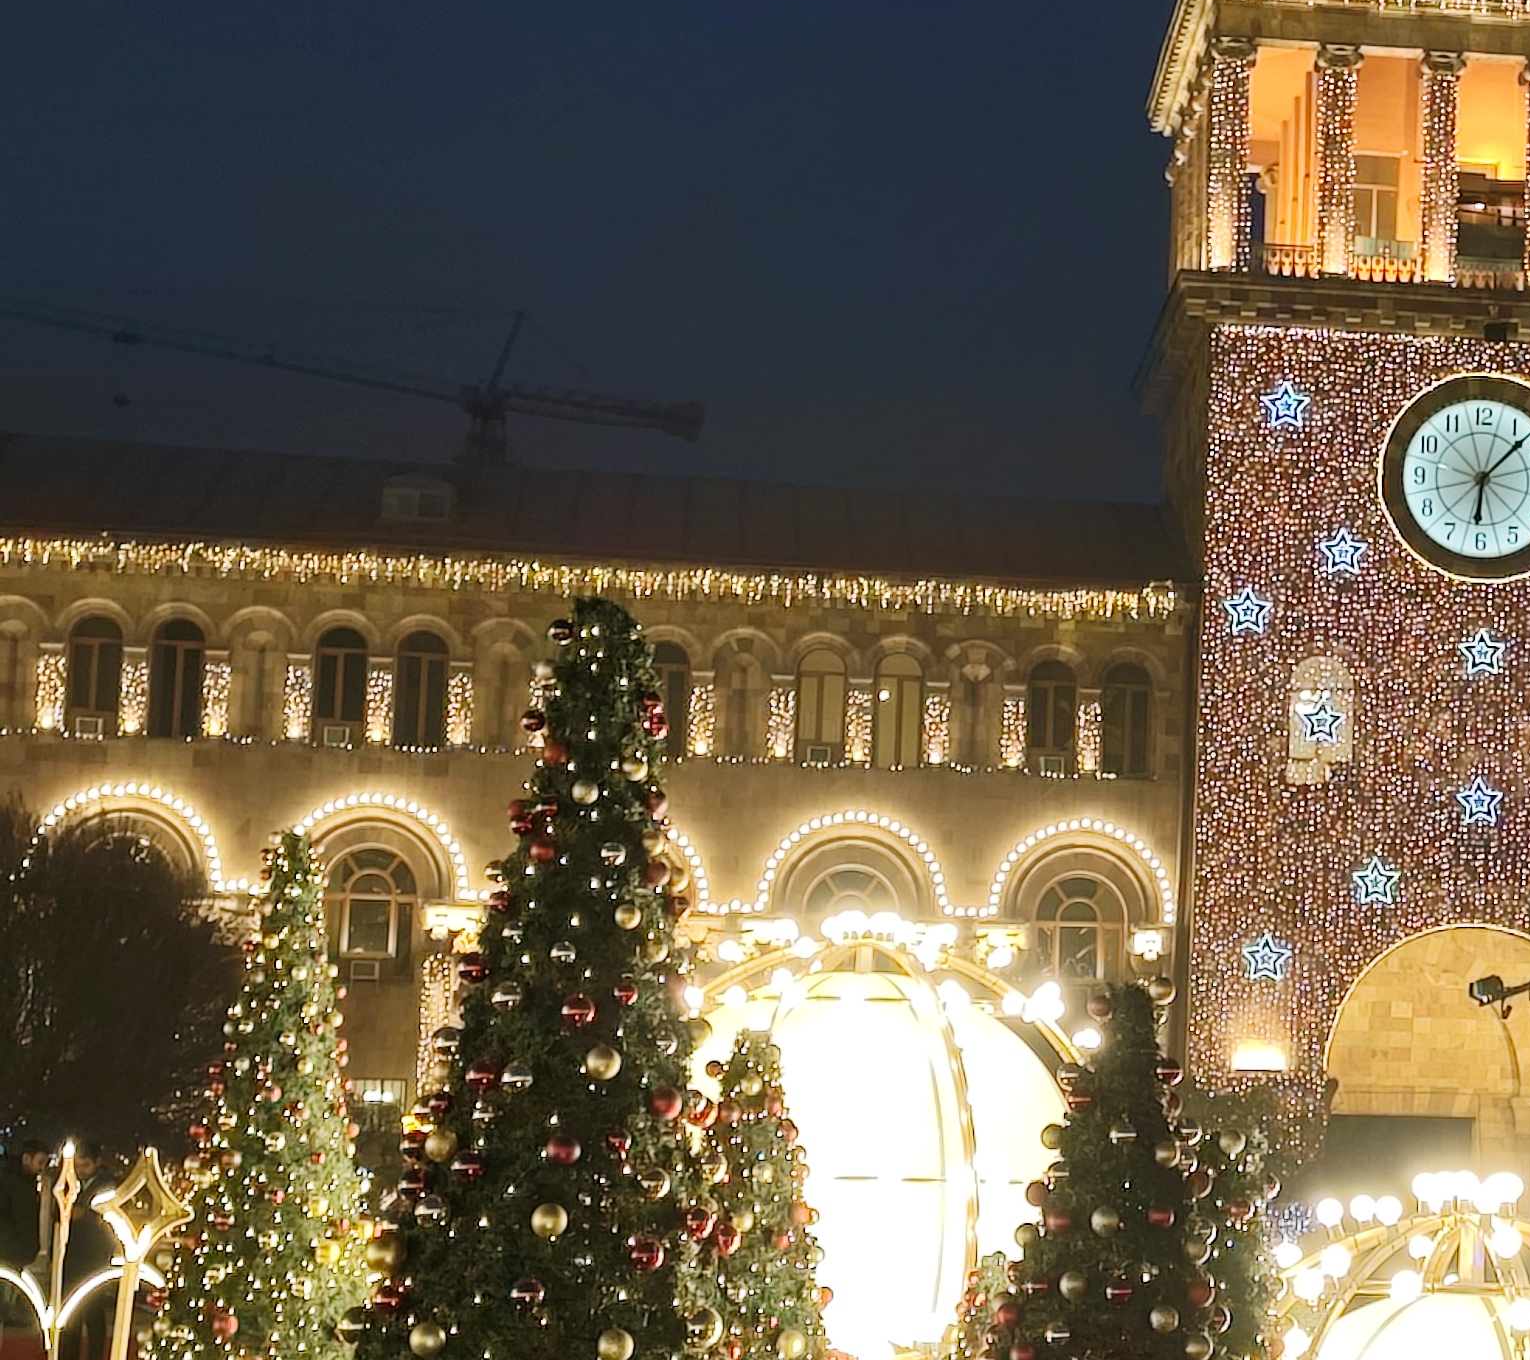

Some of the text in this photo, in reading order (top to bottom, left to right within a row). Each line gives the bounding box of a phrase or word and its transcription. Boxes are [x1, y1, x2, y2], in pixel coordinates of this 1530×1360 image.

[1447, 414, 1459, 433] 11
[1476, 407, 1493, 425] 12
[1421, 435, 1438, 454] 10
[1414, 466, 1425, 484] 9
[1422, 498, 1432, 516] 8
[1444, 522, 1456, 540] 7
[1507, 526, 1518, 544] 5
[1475, 532, 1486, 550] 6
